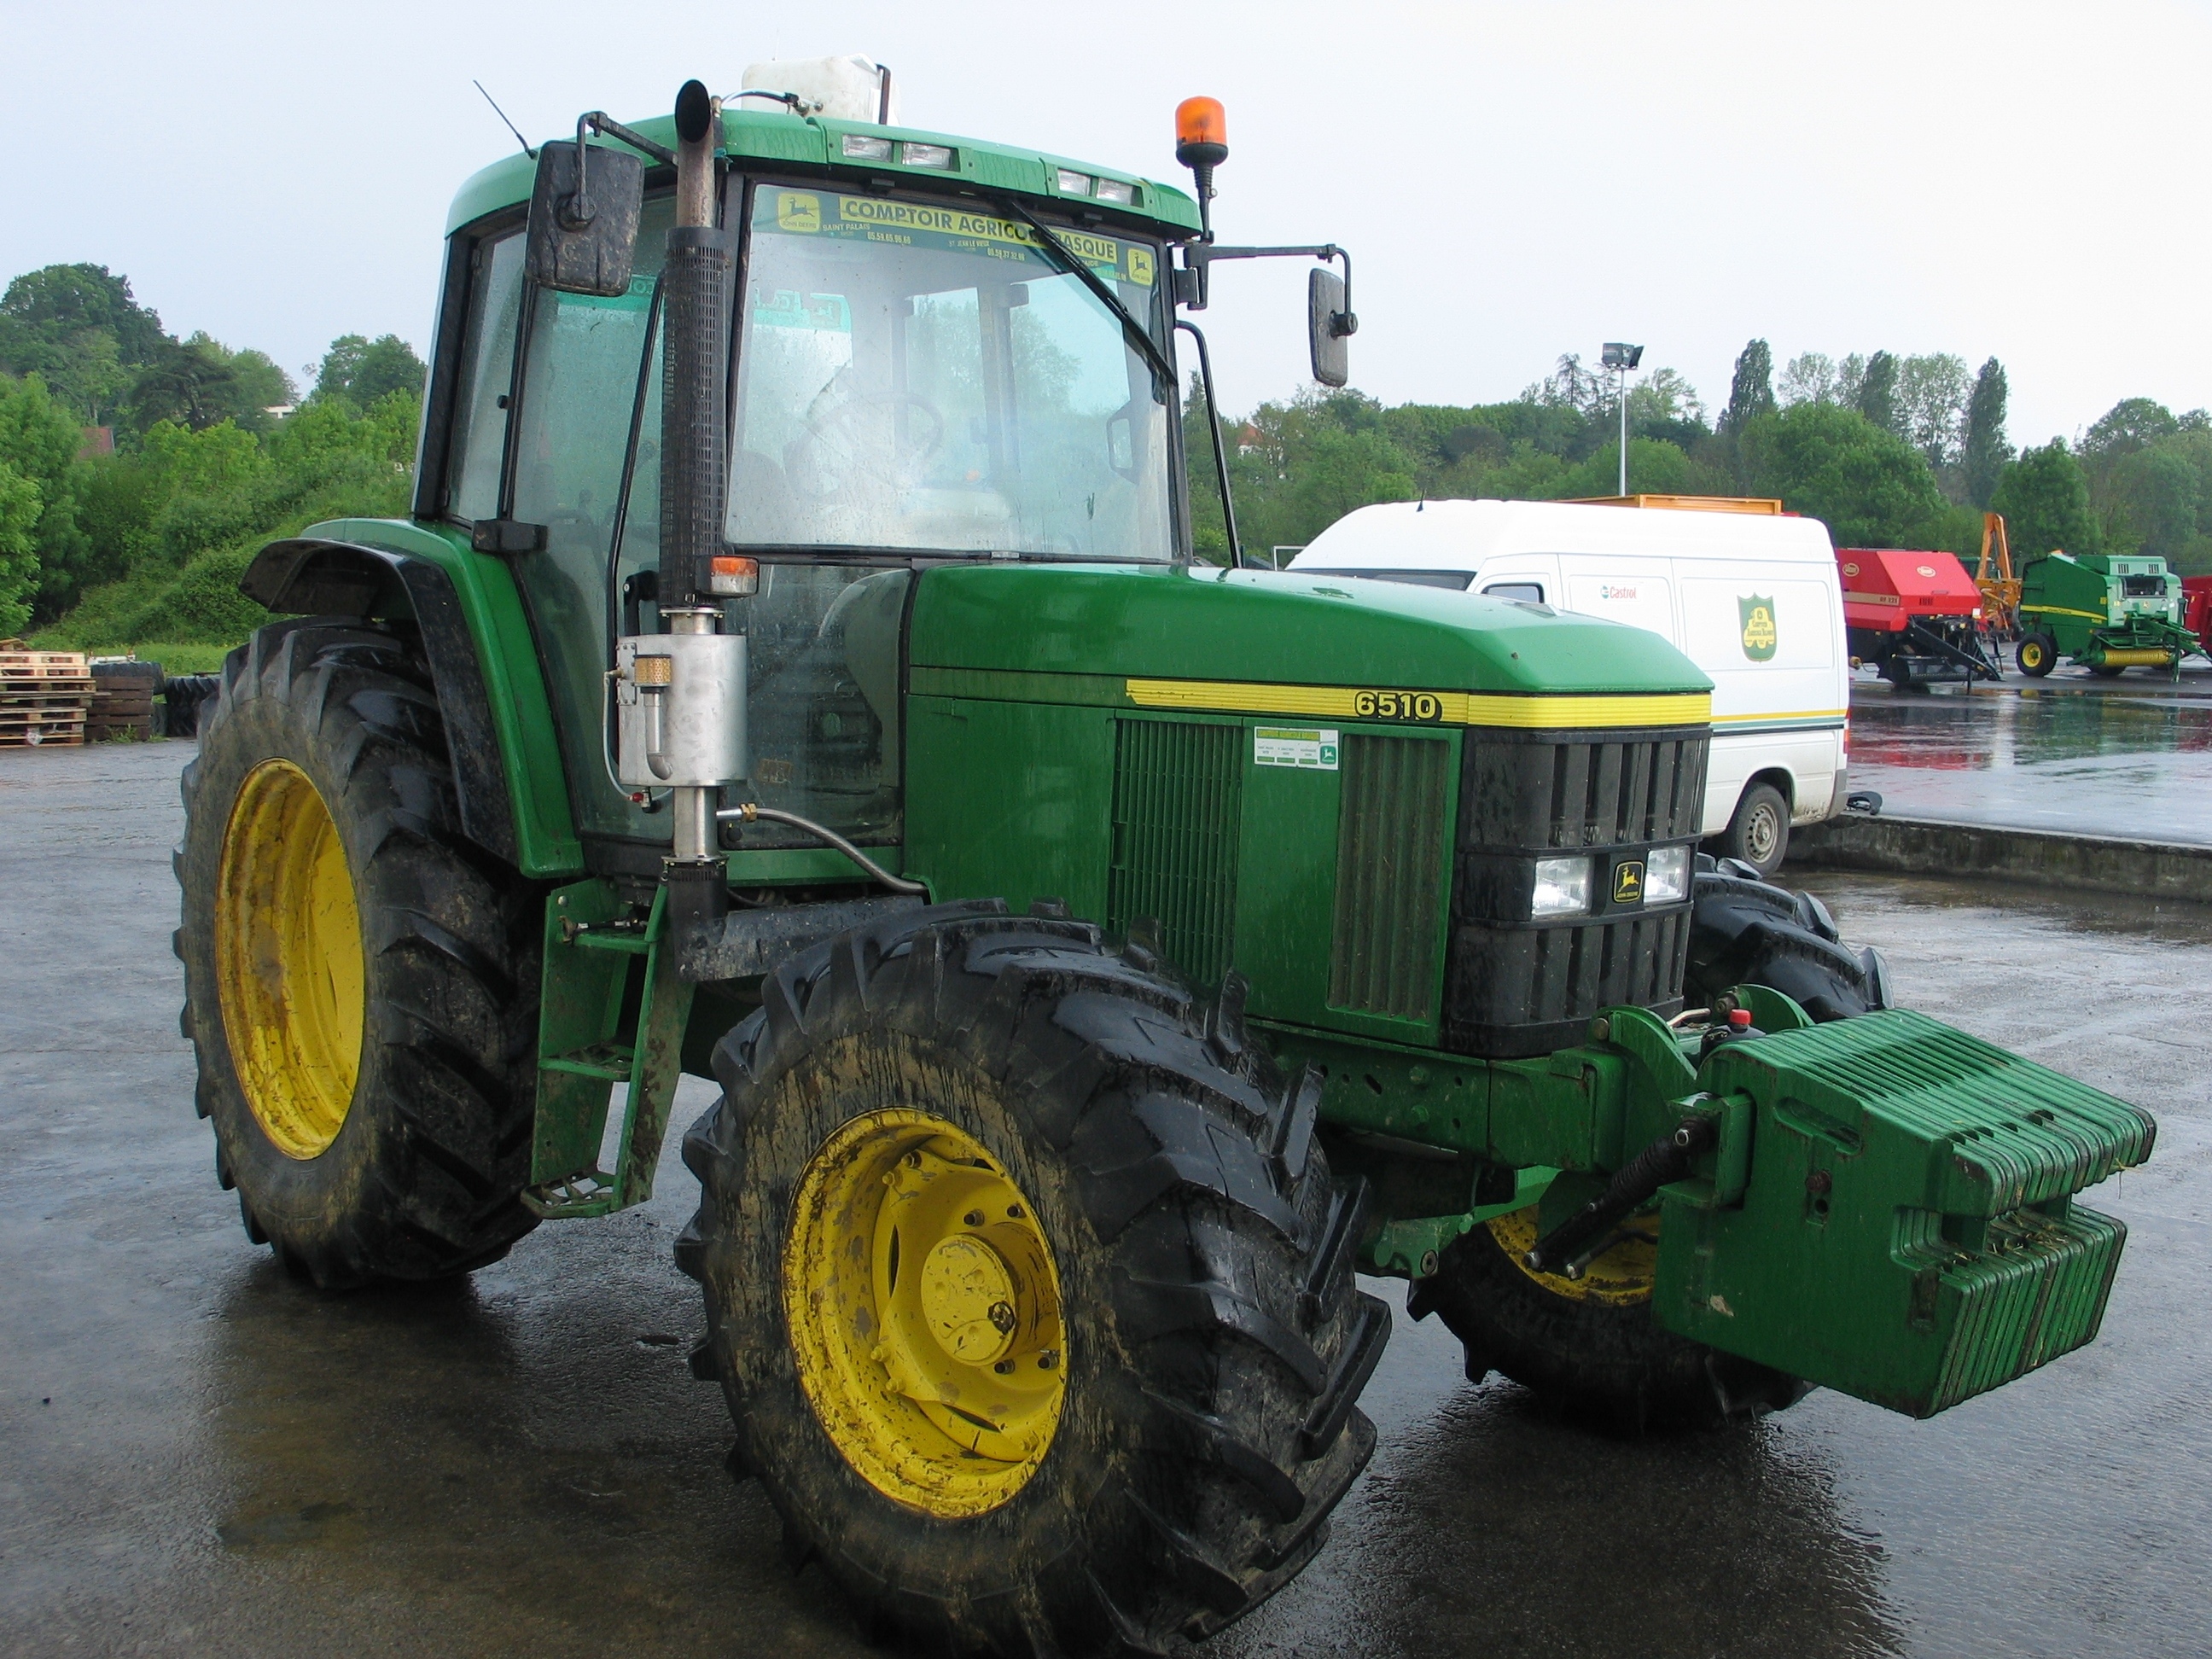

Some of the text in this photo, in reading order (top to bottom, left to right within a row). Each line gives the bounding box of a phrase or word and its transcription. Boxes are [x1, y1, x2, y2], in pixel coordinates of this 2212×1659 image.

[846, 201, 952, 229] COMPTOIR
[958, 216, 1040, 243] AGRICOL
[1610, 586, 1637, 599] Castrol
[1355, 691, 1441, 721] 6510
